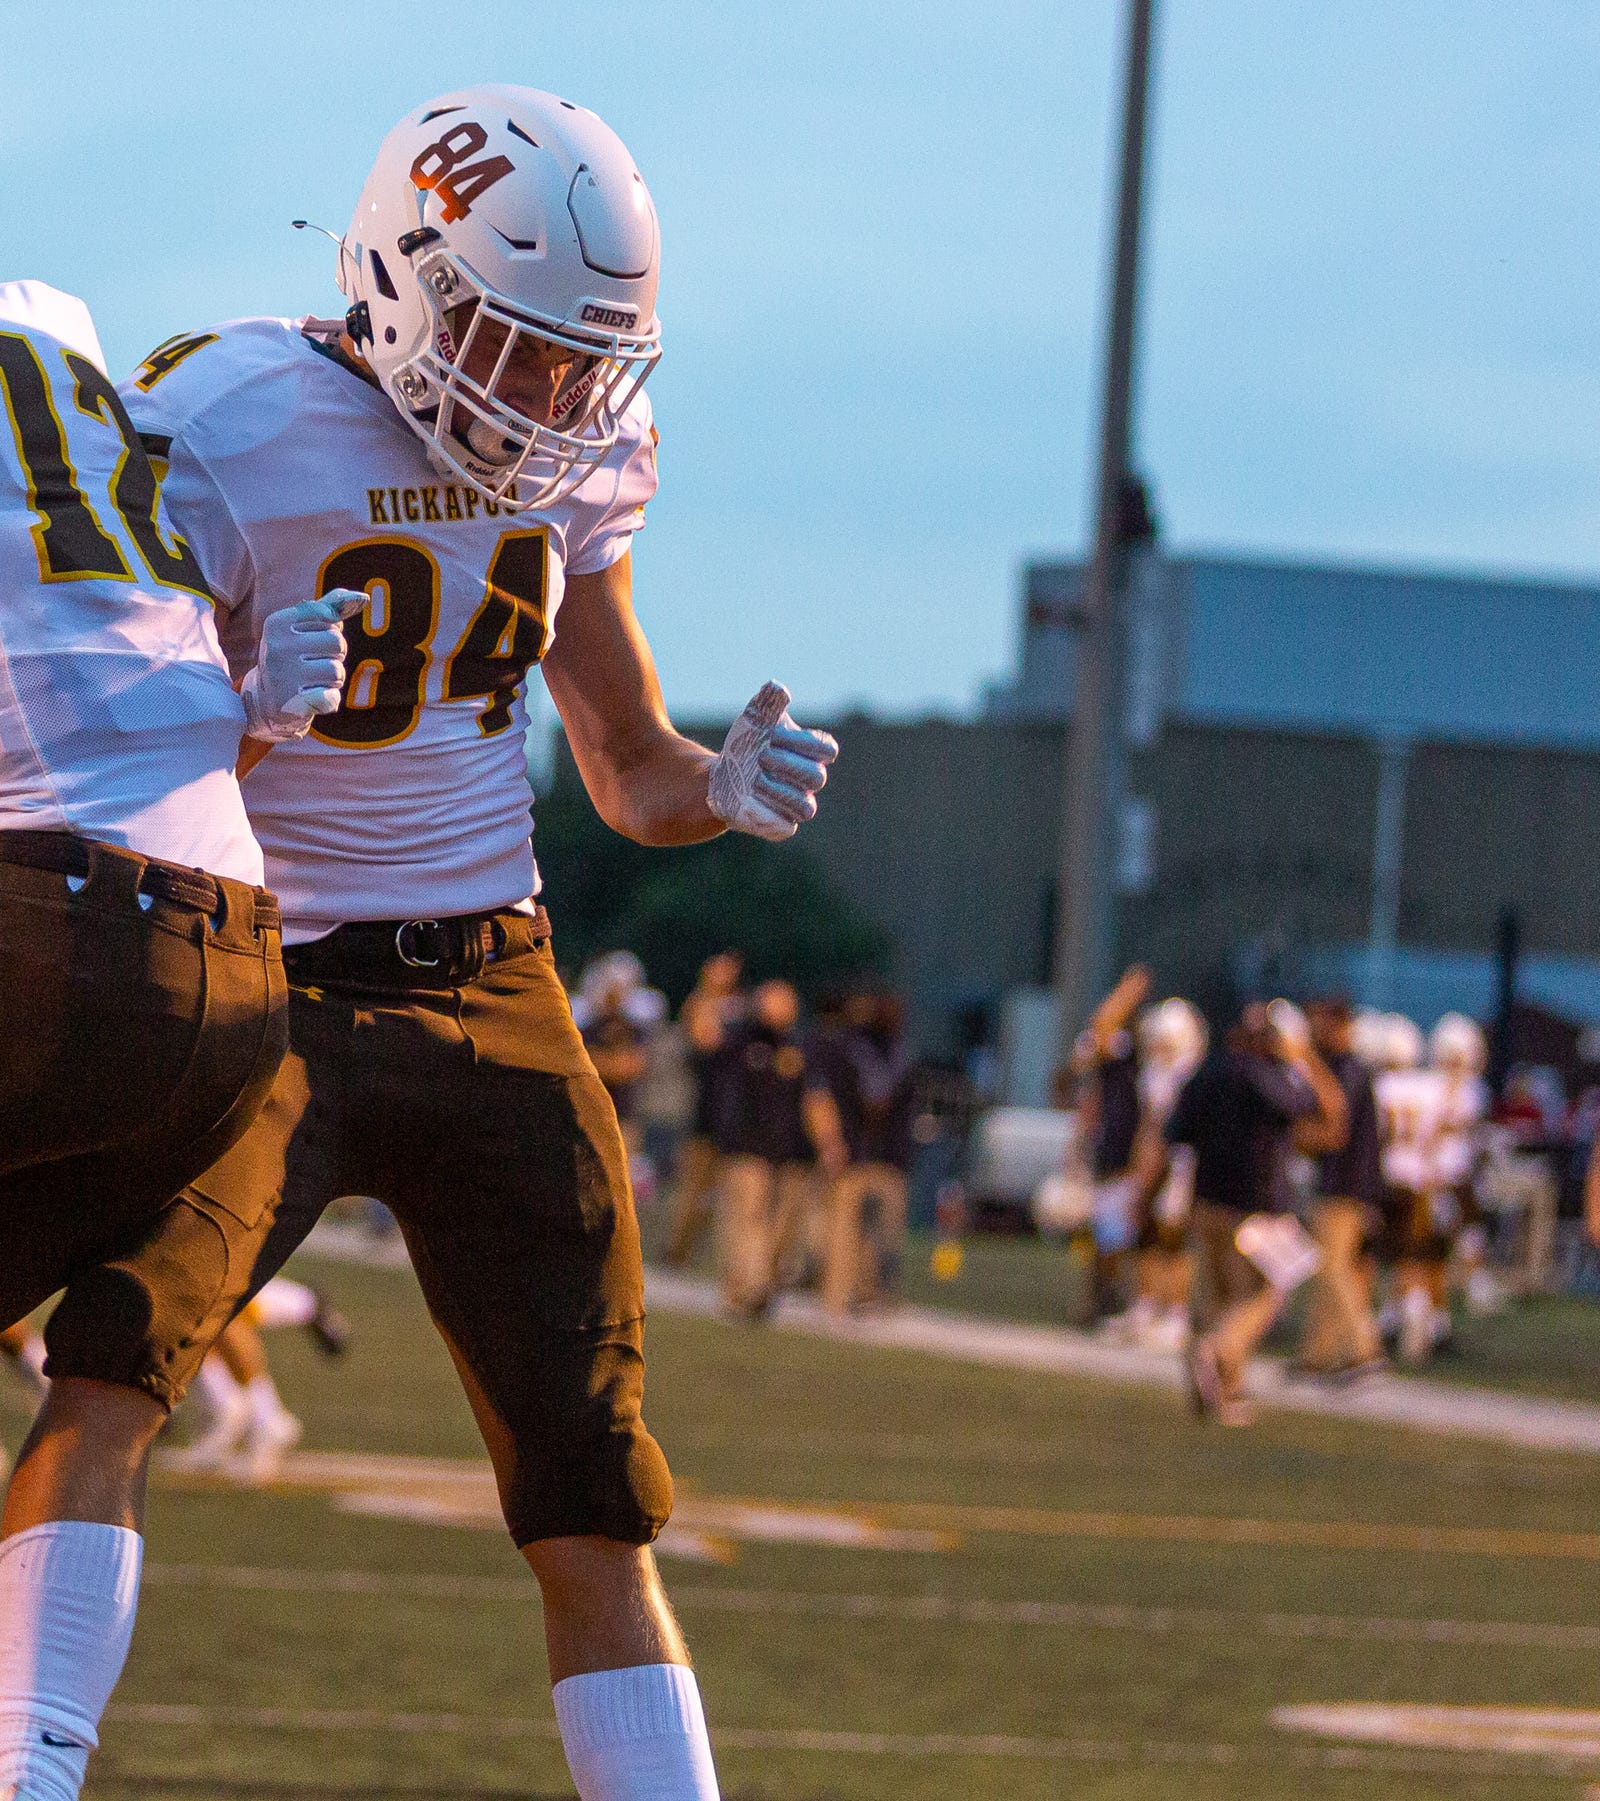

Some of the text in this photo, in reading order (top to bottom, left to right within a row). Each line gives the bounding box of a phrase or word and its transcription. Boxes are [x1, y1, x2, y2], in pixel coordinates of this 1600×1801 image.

[409, 122, 516, 225] 84
[581, 304, 637, 330] CHIEFS
[552, 370, 597, 419] Riddell
[309, 526, 549, 749] 84
